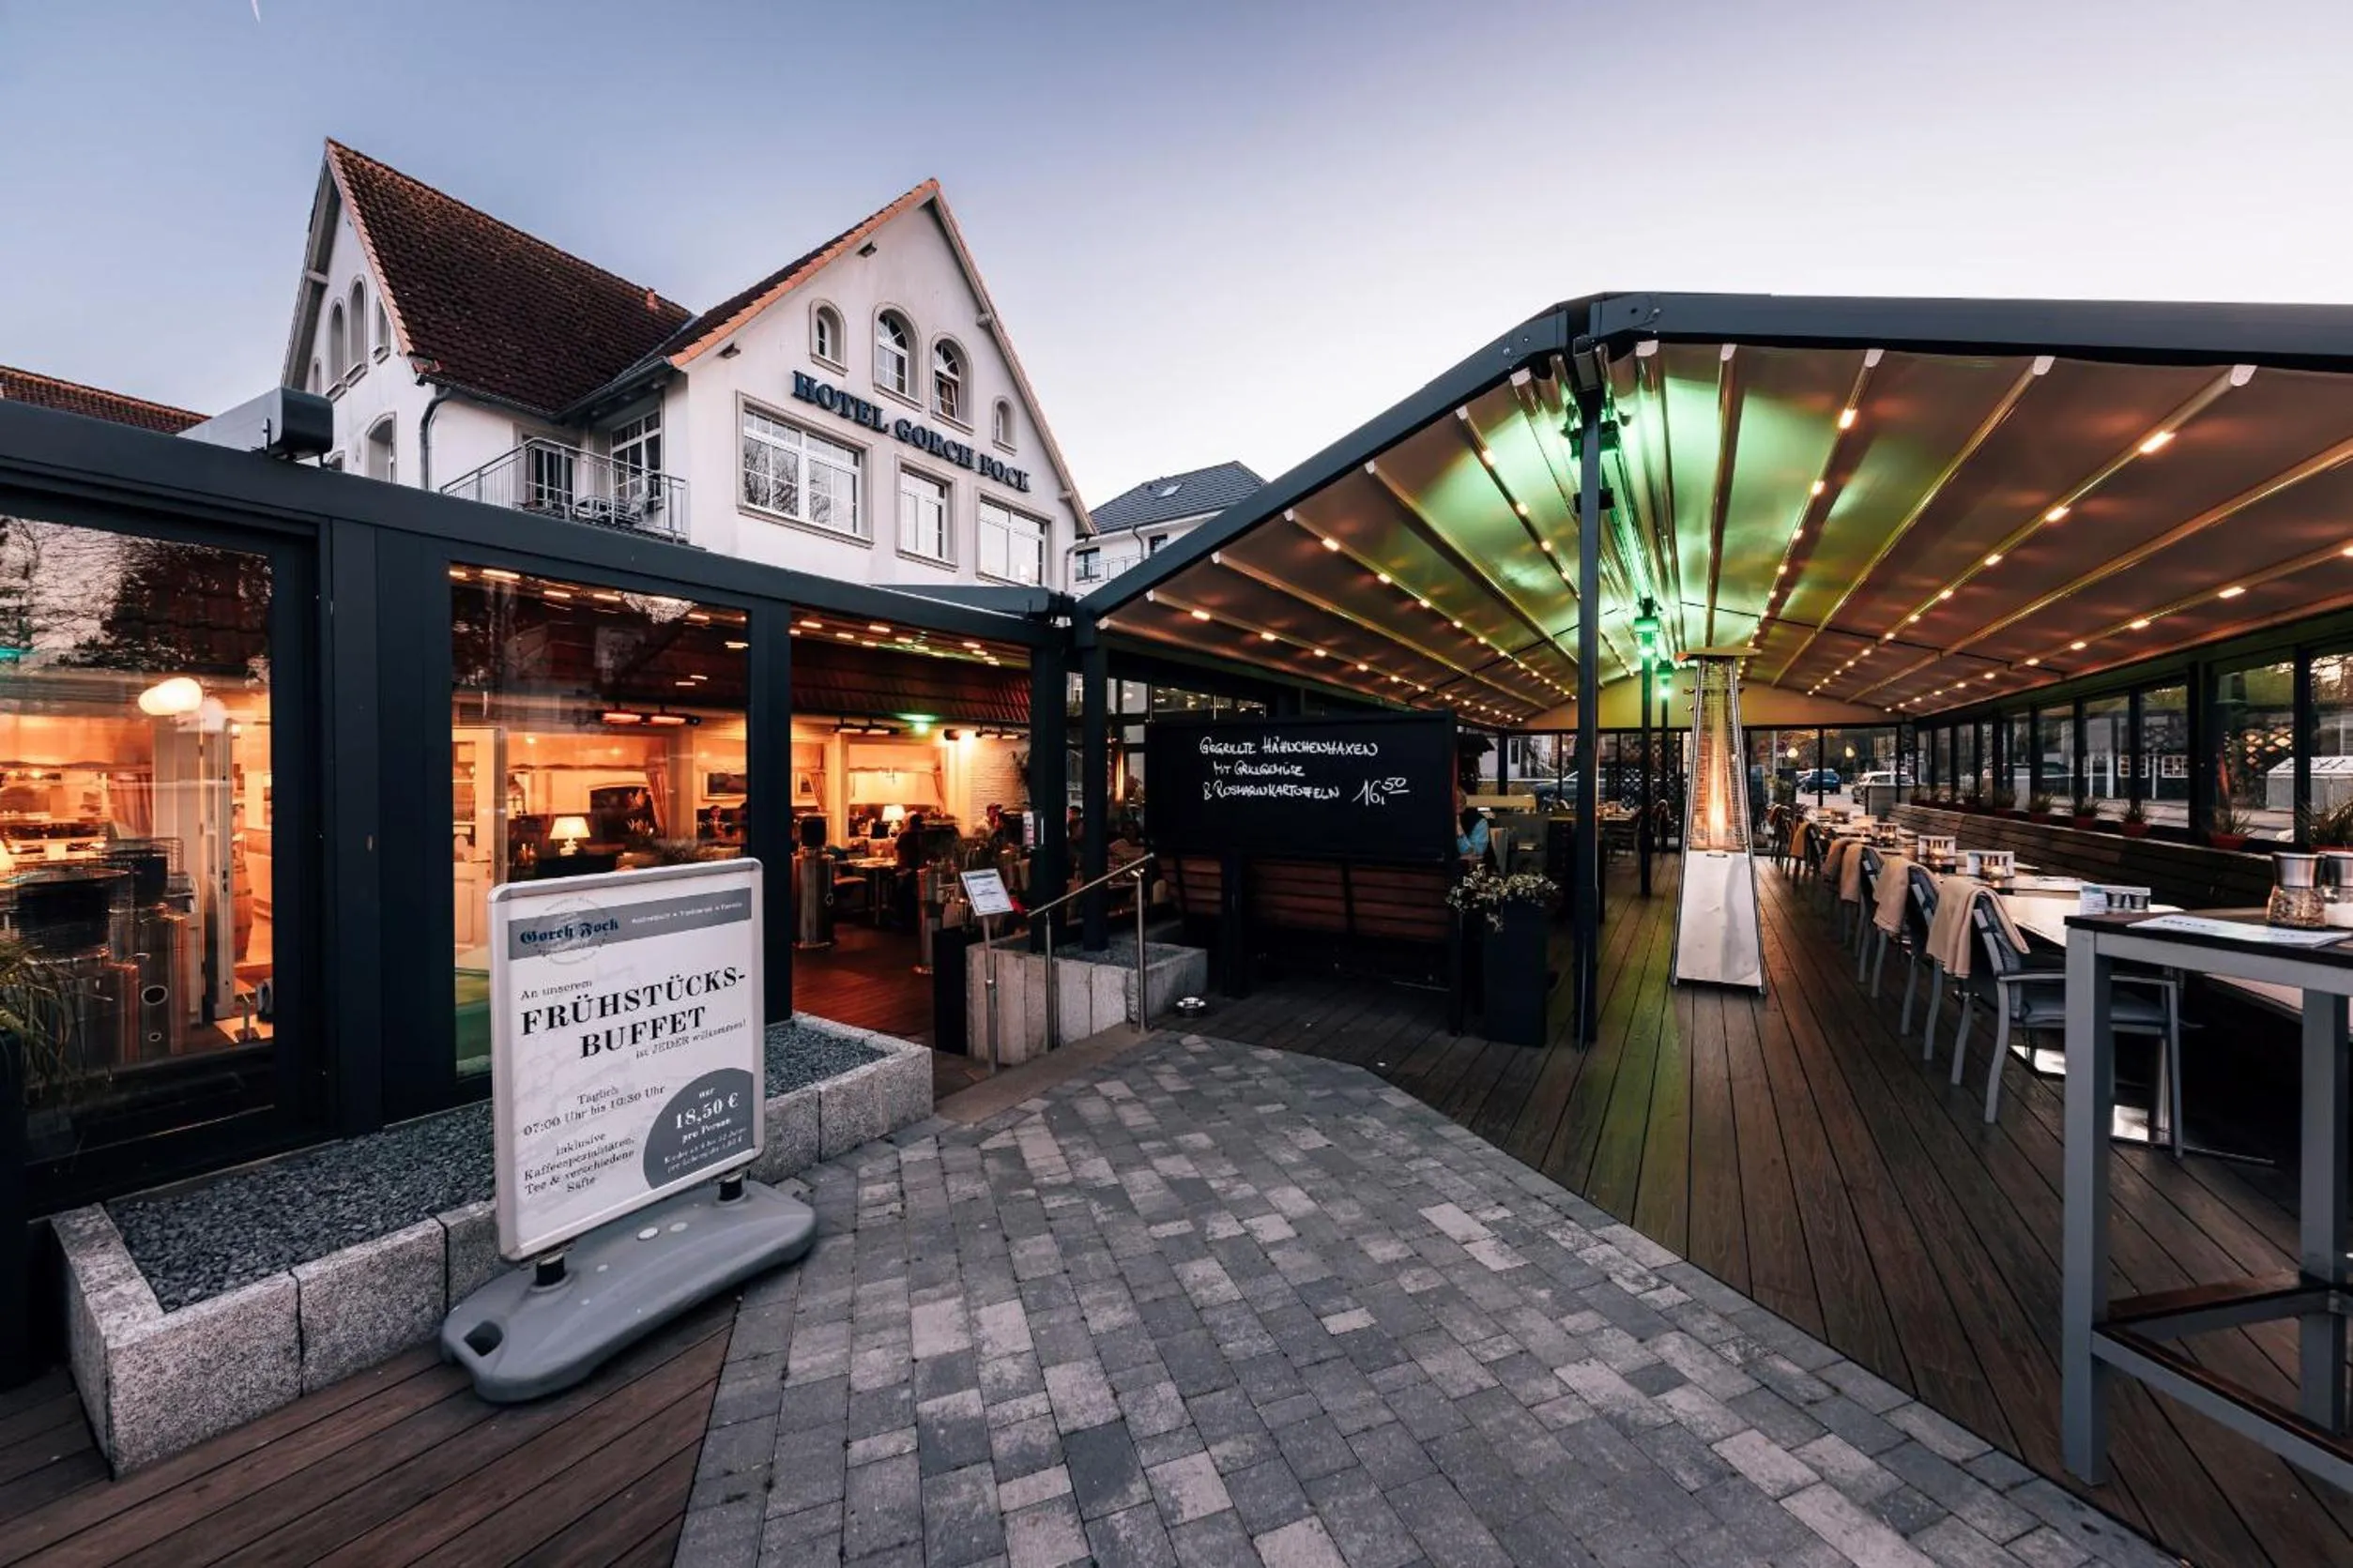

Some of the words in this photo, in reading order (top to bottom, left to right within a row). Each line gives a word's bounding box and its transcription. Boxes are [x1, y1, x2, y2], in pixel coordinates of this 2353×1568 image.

[791, 370, 890, 434] HOTEL
[894, 418, 976, 469] GORCH
[978, 453, 1031, 493] FOCK
[519, 925, 573, 945] Gorch
[579, 918, 619, 938] Fock
[520, 989, 540, 1001] An
[542, 980, 593, 997] unserem
[521, 966, 746, 1036] FRÜHSTÜCKS-
[579, 1006, 705, 1059] BUFFET
[652, 1036, 690, 1055] JEDER
[523, 1116, 561, 1136] 07:00
[564, 1108, 588, 1124] Uhr
[590, 1104, 606, 1116] bis
[645, 1086, 665, 1099] Uhr
[676, 1098, 724, 1129] 18,50
[727, 1091, 739, 1108] €
[556, 1133, 606, 1156] inklusive
[525, 1181, 547, 1195] Tee
[564, 1149, 634, 1180] verschiedene
